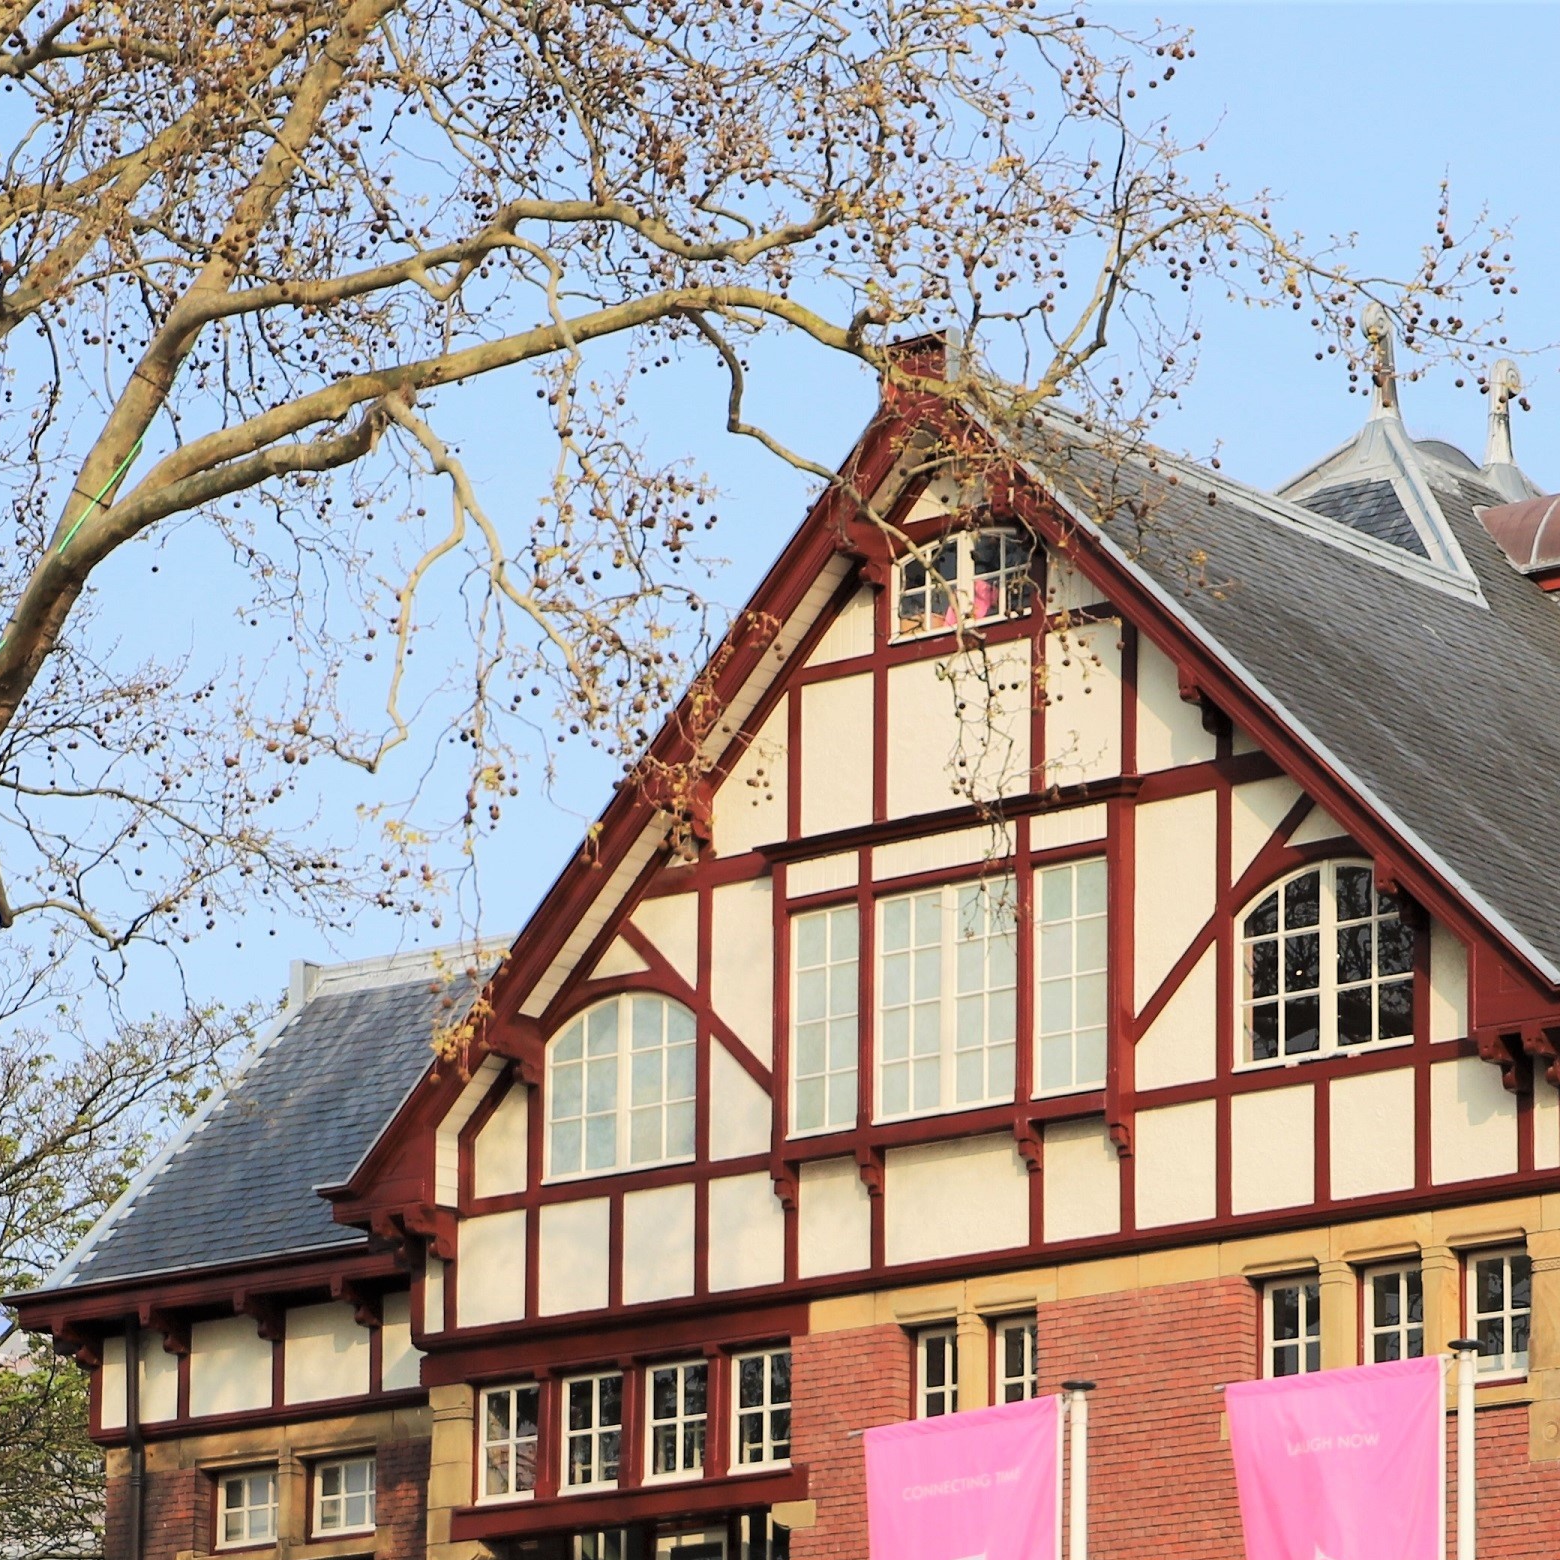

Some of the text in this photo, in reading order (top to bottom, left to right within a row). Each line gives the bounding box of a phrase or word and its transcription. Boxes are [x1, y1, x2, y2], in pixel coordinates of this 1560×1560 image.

[1286, 1432, 1380, 1456] LAUGH NOW
[902, 1473, 991, 1501] CONNECTING
